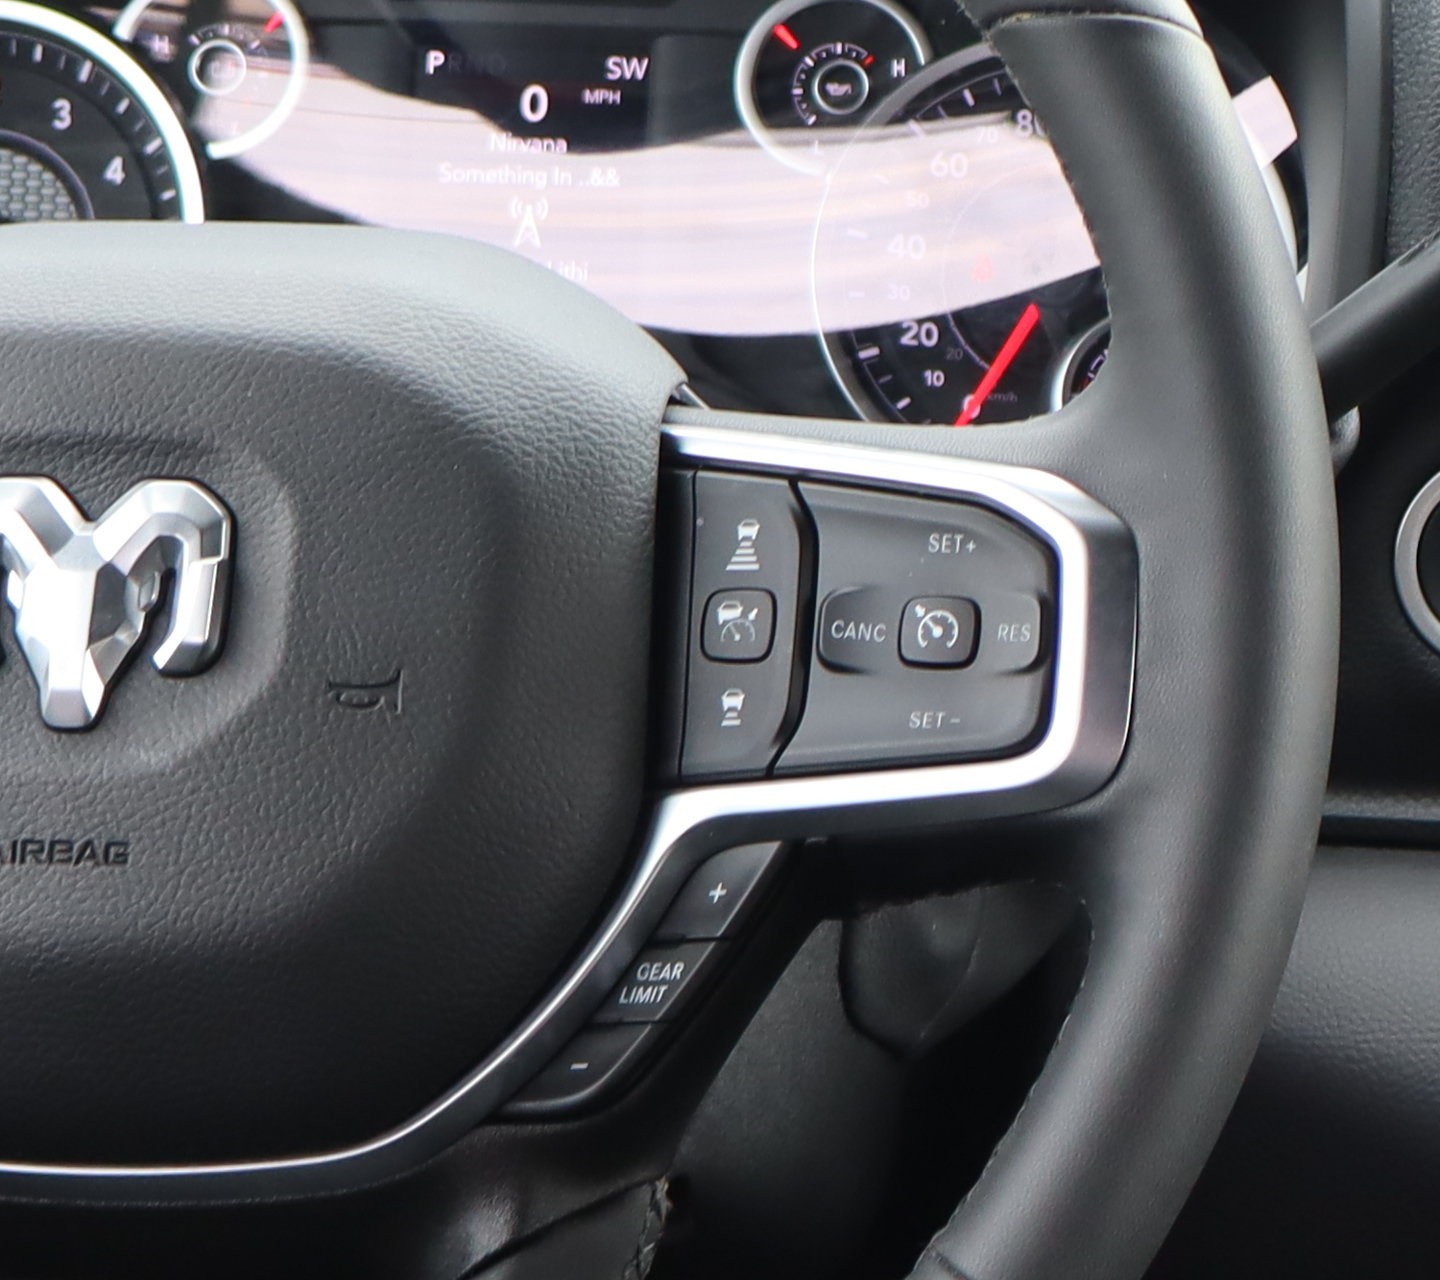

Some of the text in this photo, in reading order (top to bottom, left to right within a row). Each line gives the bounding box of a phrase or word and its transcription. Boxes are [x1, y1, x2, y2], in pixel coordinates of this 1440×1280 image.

[605, 56, 649, 81] SW
[891, 57, 906, 78] H
[520, 84, 549, 122] 0
[582, 89, 621, 105] MPH
[51, 99, 72, 129] 3
[489, 132, 567, 153] Nirvana
[976, 126, 999, 144] 70
[102, 155, 126, 186] 4
[439, 163, 547, 188] Something
[554, 167, 572, 185] In
[930, 150, 968, 179] 60
[887, 233, 926, 260] 40
[899, 321, 939, 348] 20
[923, 370, 945, 387] 10
[831, 620, 887, 642] CANC
[998, 623, 1032, 642] RES
[636, 962, 685, 981] GEAR
[619, 986, 668, 1004] LIMIT
